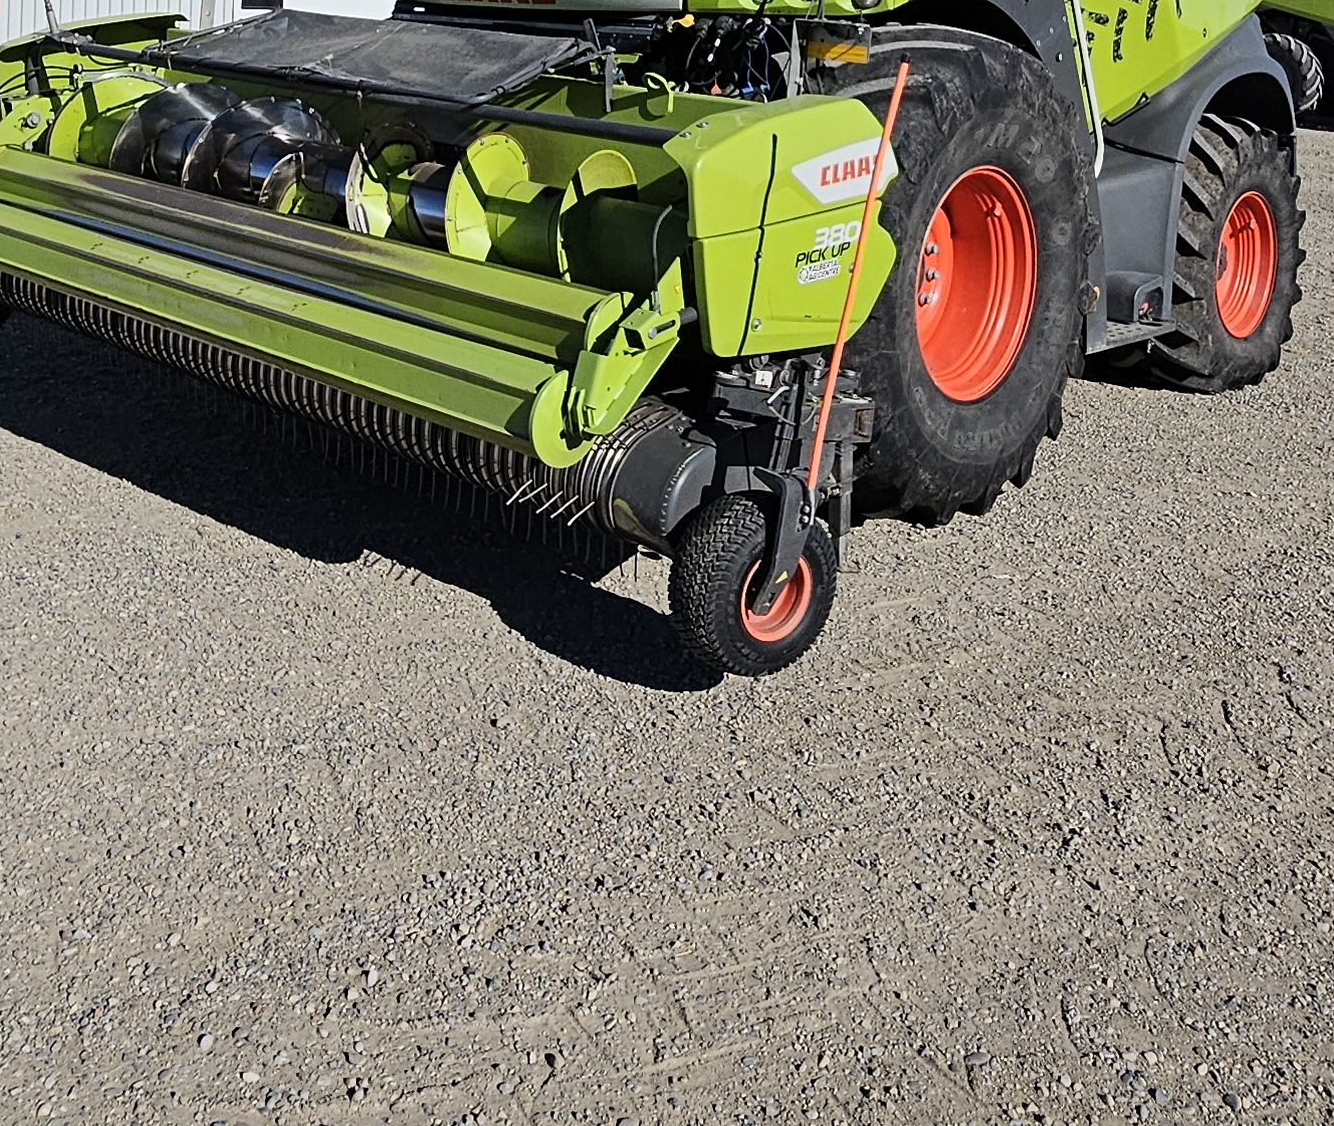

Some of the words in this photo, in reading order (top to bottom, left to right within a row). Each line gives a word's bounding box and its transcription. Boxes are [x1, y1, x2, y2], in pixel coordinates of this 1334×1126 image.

[820, 154, 879, 187] CLAA
[811, 220, 862, 251] 380
[795, 245, 829, 268] PICK
[831, 241, 851, 258] UP
